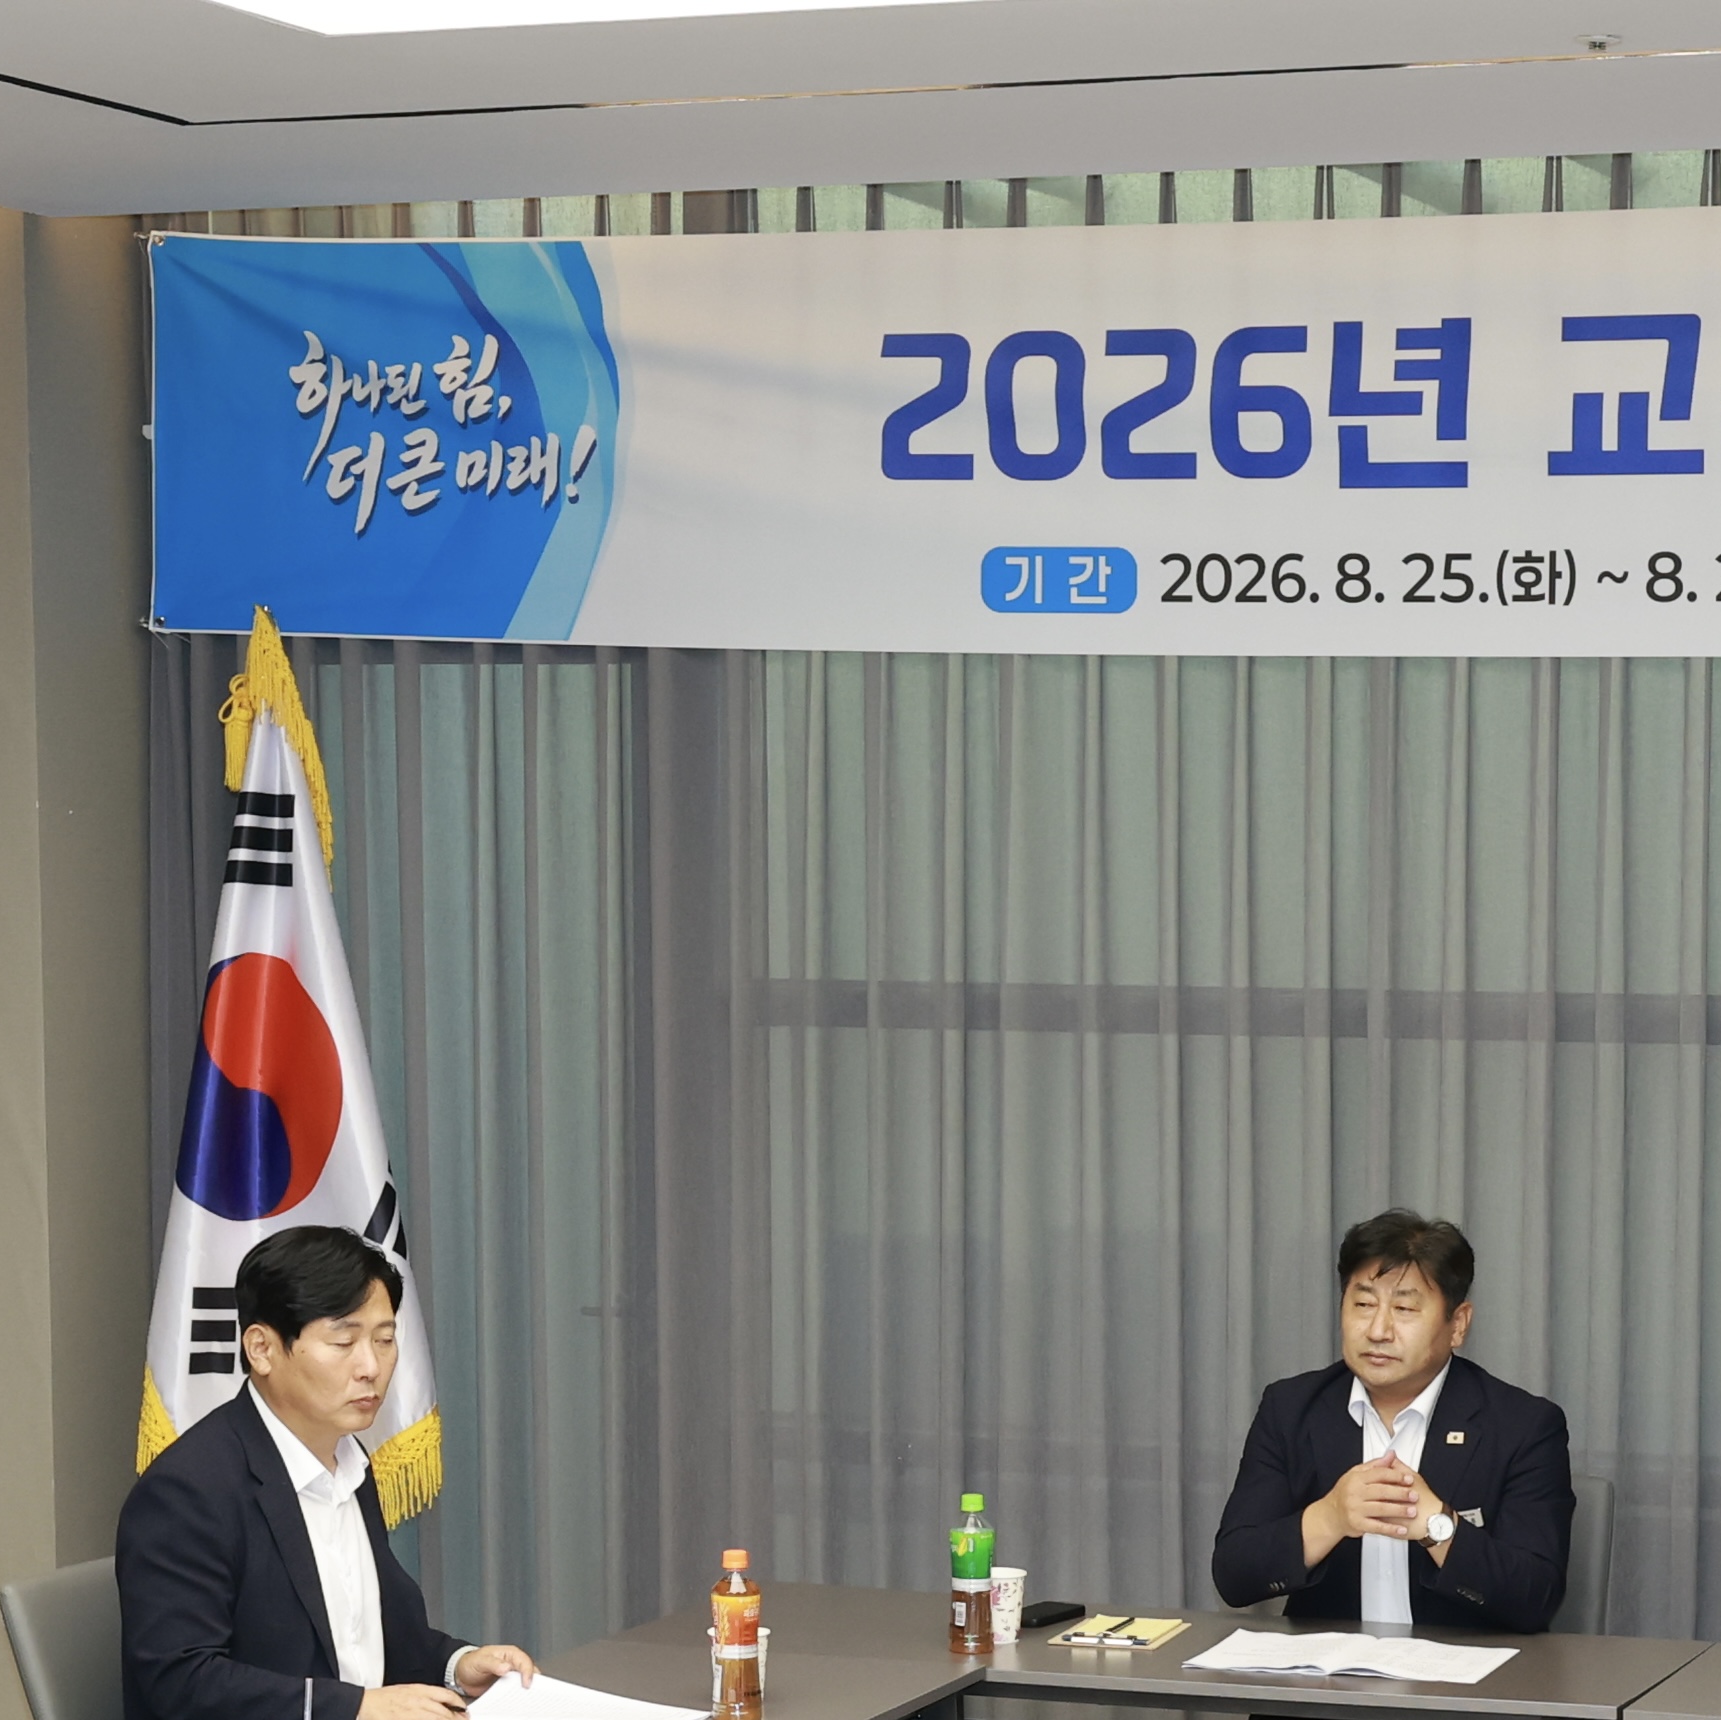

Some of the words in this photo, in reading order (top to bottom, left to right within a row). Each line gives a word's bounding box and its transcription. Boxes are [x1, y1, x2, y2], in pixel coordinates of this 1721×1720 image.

[289, 330, 428, 482] 하나된
[433, 333, 512, 424] 힘,
[883, 319, 1471, 489] 2026년
[326, 431, 386, 535] 더
[386, 427, 445, 511] 큰
[455, 424, 598, 508] 미래!
[1160, 552, 1321, 605] 2026.
[1335, 552, 1385, 605] 8.
[1401, 549, 1576, 606] 25.(화)
[1645, 550, 1698, 604] 8.
